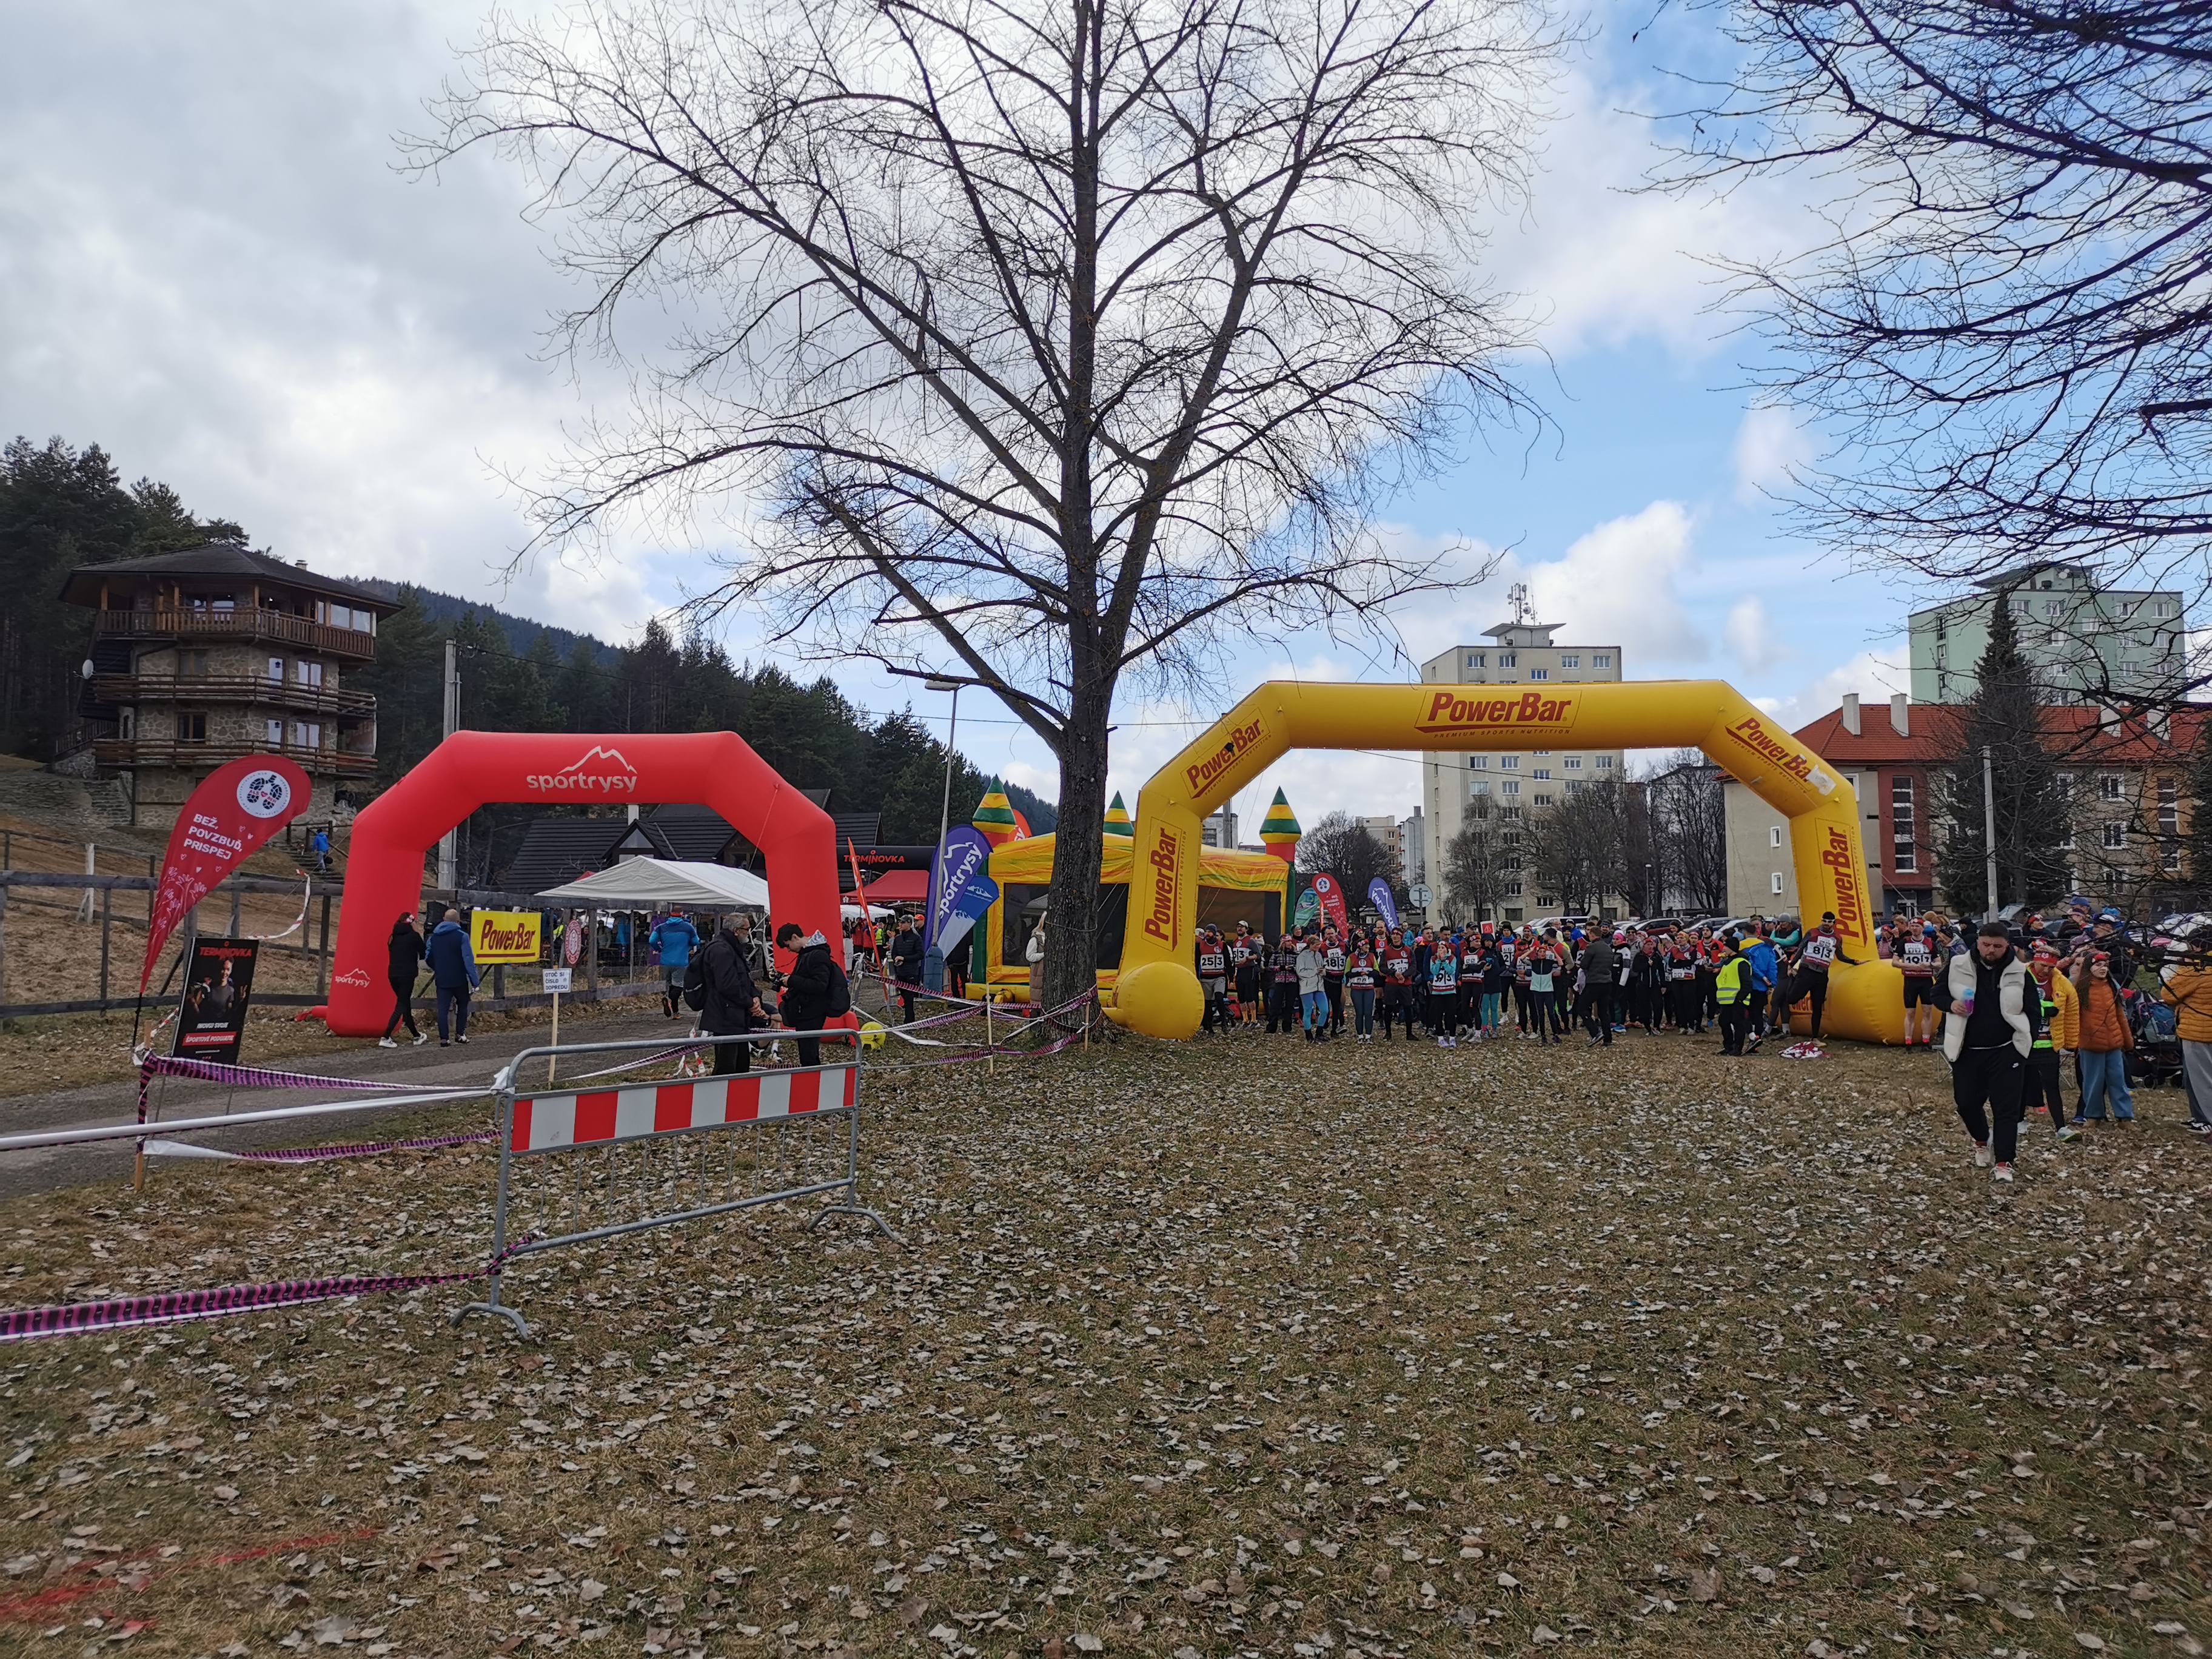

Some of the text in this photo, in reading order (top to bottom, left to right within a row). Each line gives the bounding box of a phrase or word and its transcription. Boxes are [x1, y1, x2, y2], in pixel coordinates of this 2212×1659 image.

[1427, 692, 1572, 722] PowerBar
[1735, 717, 1812, 783] PowerBa
[526, 772, 637, 793] sportrysy
[193, 813, 219, 830] BEŽ,
[183, 838, 232, 860] PRISPEJ
[939, 843, 982, 919] sportrysy
[1145, 827, 1177, 941] PowerBar
[1822, 826, 1860, 938] PowerBar
[480, 919, 535, 950] PowerBar
[335, 976, 370, 988] sportrysy
